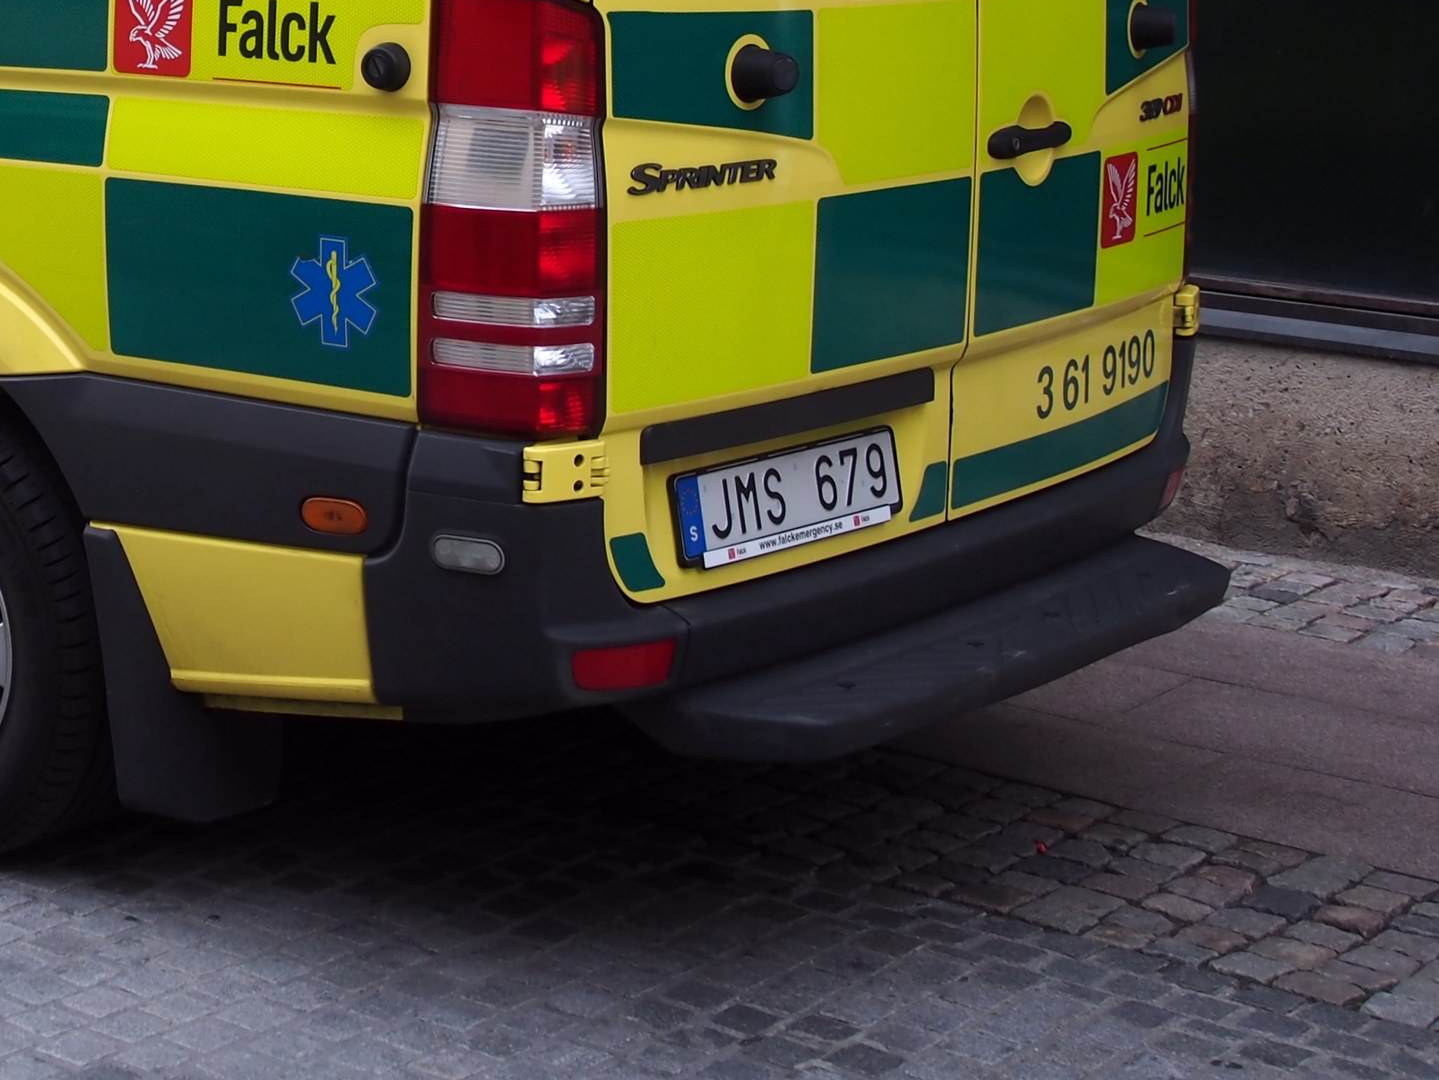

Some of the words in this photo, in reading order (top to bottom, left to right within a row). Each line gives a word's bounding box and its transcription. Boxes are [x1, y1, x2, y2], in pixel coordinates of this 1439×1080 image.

[626, 158, 778, 196] SPRINTER
[1146, 156, 1185, 217] Falck
[1036, 365, 1054, 420] 3
[1062, 353, 1090, 411] 61
[1102, 328, 1156, 396] 9190
[711, 467, 787, 540] JMS
[814, 442, 888, 512] 679
[689, 525, 699, 542] S
[758, 520, 844, 551] www.falckemergency.se
